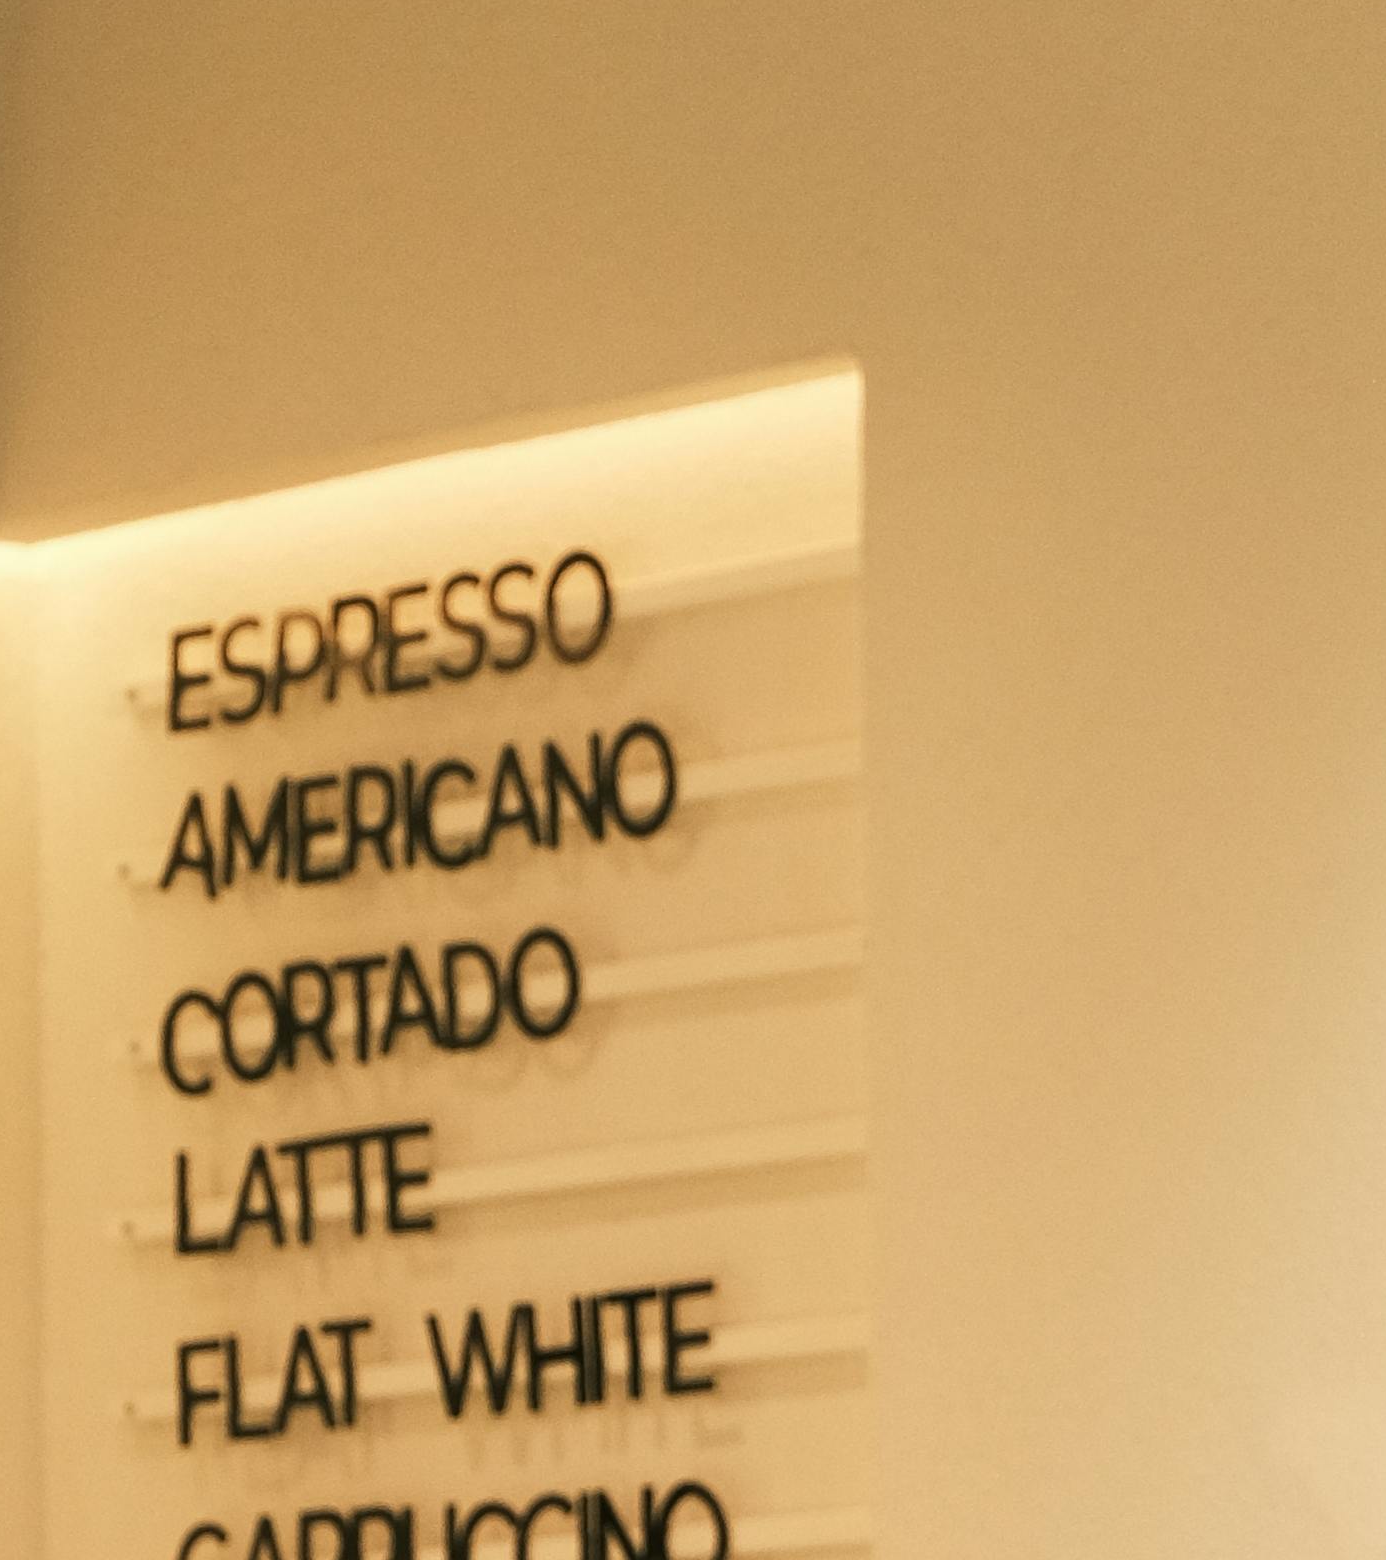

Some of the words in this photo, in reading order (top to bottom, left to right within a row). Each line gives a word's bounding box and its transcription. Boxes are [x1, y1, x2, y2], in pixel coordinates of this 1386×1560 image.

[166, 549, 615, 733] ESPRESSO
[160, 719, 676, 899] AMERICANO
[160, 926, 580, 1095] CORTADO
[173, 1121, 436, 1255] LATTE
[177, 1318, 372, 1445] FLAT
[426, 1280, 716, 1419] WHITE
